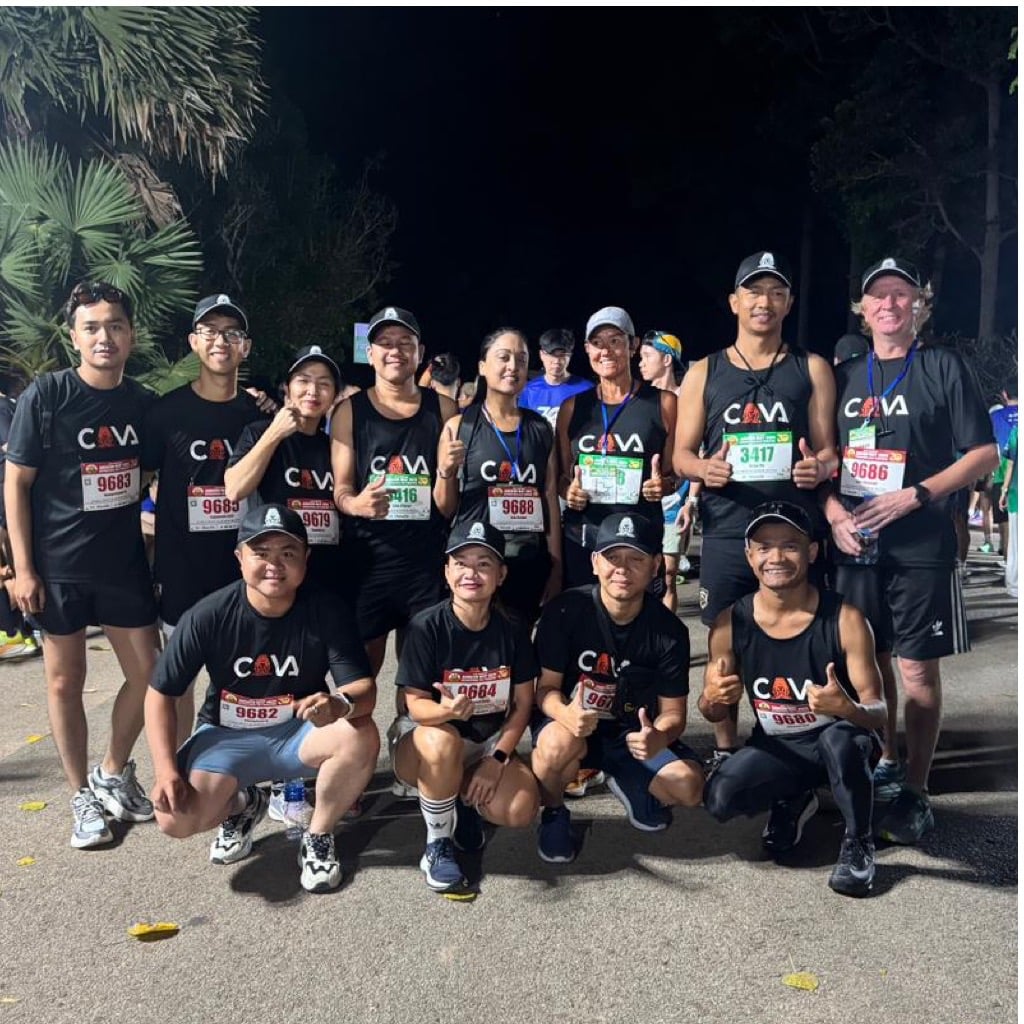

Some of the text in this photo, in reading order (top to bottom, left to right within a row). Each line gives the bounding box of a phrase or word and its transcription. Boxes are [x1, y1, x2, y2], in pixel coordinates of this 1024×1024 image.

[740, 446, 775, 464] 3417
[850, 462, 889, 481] 9686
[97, 472, 131, 492] 9683
[502, 499, 534, 515] 9688
[303, 511, 331, 529] 9679
[236, 706, 279, 719] 9682
